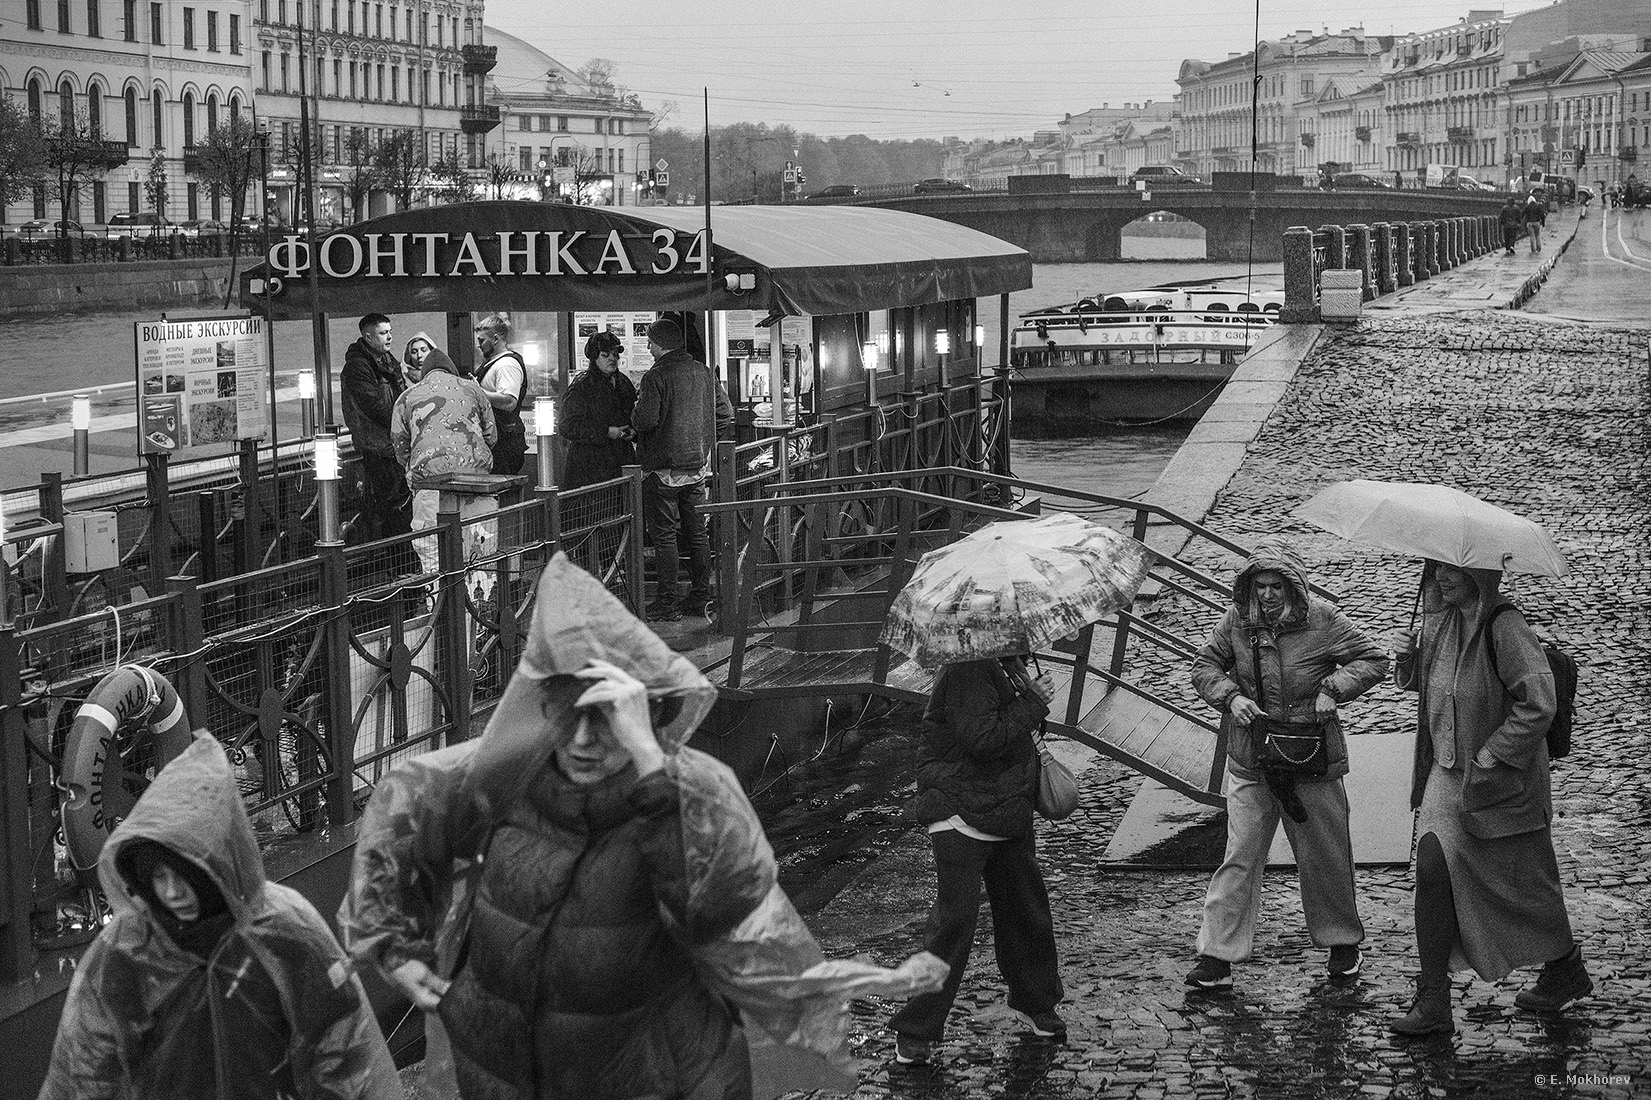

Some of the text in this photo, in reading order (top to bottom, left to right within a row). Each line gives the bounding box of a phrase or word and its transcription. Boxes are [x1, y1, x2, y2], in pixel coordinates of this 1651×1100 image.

[268, 228, 714, 279] ФОНТАНКА 34
[143, 319, 261, 343] ВОДНЫЕ ЭКСКУРСИИ
[1101, 330, 1222, 343] ЗАДОРНЫЙ
[191, 347, 212, 355] ДНЕВНЫЕ
[190, 357, 214, 365] ЭКСКУРСИИ
[193, 378, 212, 386] НОЧНЫЕ
[191, 388, 215, 396] ЭКСКУРСИИ
